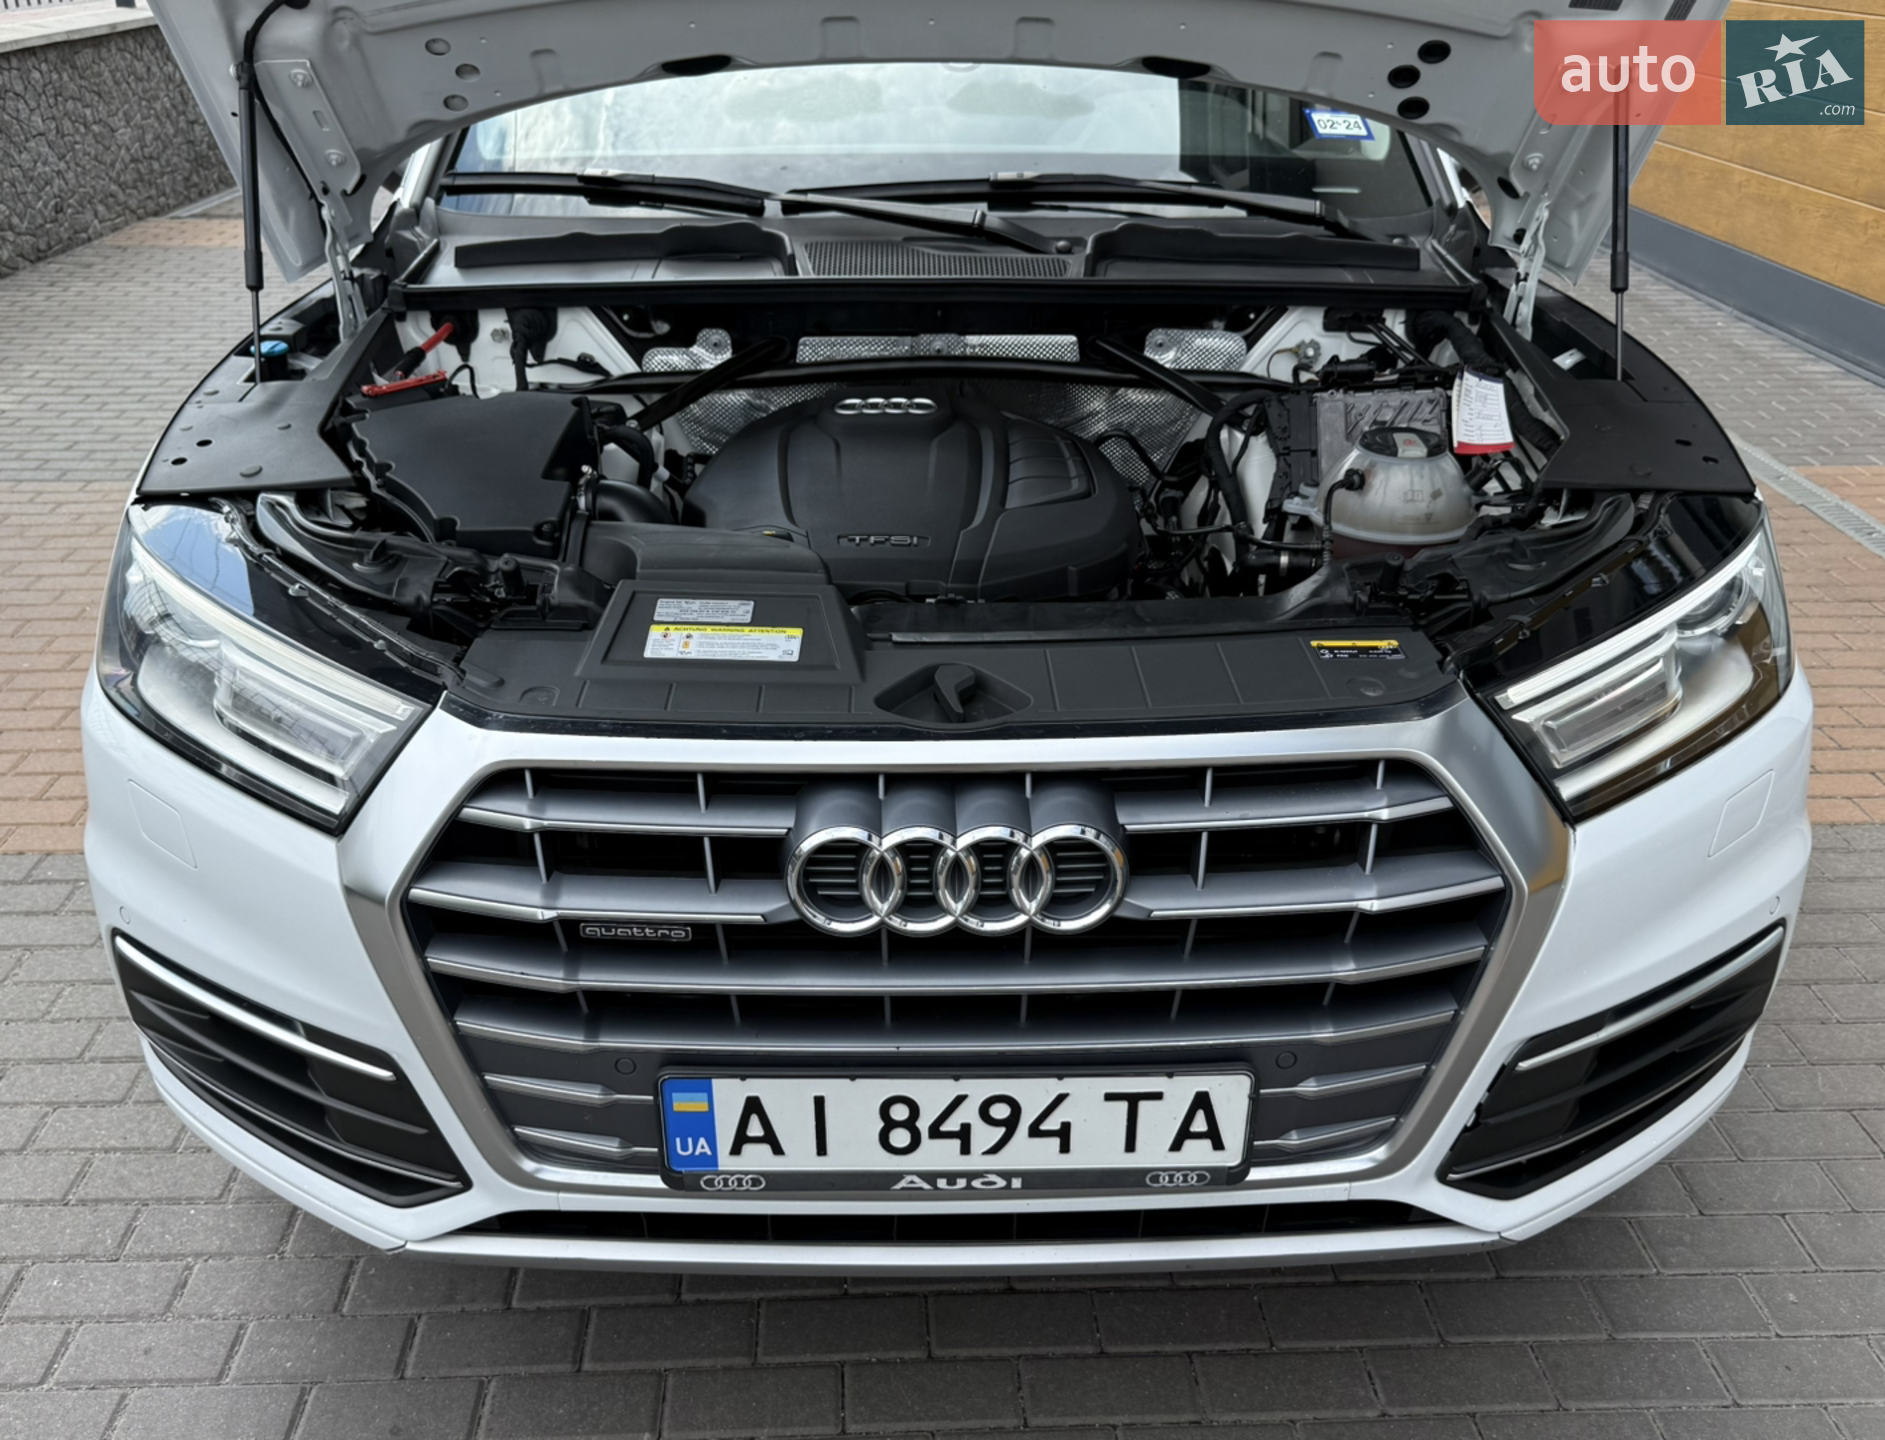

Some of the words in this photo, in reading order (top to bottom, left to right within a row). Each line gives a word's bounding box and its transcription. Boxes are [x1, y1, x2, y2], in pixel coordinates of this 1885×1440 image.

[847, 535, 918, 545] TFSI
[585, 926, 686, 938] quattro
[729, 1095, 828, 1156] AI
[878, 1093, 1072, 1156] 8494
[1103, 1090, 1226, 1153] TA
[675, 1136, 712, 1156] UA
[889, 1173, 1023, 1190] Audi
